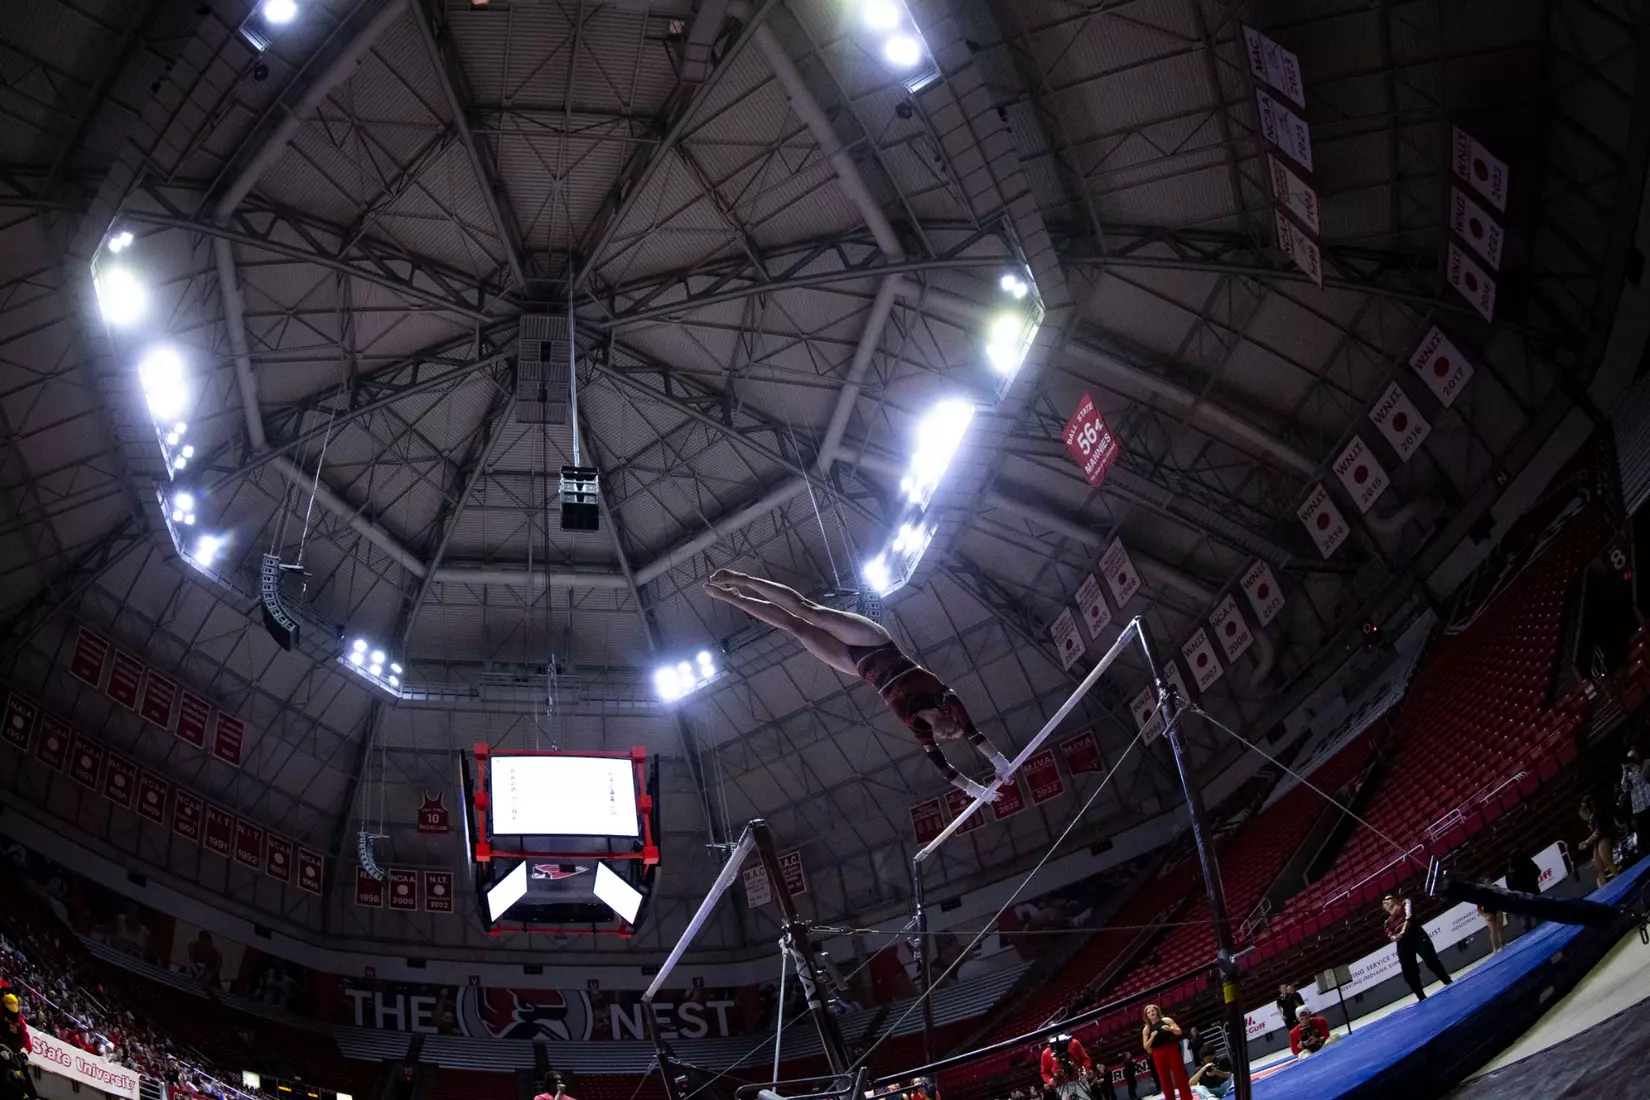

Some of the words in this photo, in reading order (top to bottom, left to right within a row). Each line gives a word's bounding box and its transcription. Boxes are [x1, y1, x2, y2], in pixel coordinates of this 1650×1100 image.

[1262, 97, 1276, 141] NCAA
[1443, 367, 1465, 397] 2017
[1067, 424, 1078, 445] BALL
[1077, 402, 1094, 421] STATE
[1077, 422, 1097, 455] 56
[1402, 426, 1422, 452] 2016
[1085, 432, 1112, 475] MANNIES
[1362, 477, 1382, 503] 2015
[1325, 527, 1344, 550] 2014
[1611, 549, 1626, 570] 8
[1212, 602, 1235, 628] NCAA
[1228, 633, 1248, 655] 2009
[1200, 665, 1217, 686] 2007
[11, 701, 31, 719] NAIA
[44, 721, 67, 739] NCAA
[75, 741, 100, 758] NCAA
[108, 759, 134, 777] NCAA
[141, 777, 166, 794] NCAA
[1036, 783, 1059, 798] 2022
[999, 800, 1020, 814] 2022
[427, 813, 440, 824] 10
[209, 836, 228, 850] 1991
[268, 840, 291, 854] NCAA
[238, 848, 257, 864] 1992
[300, 852, 322, 867] NCAA
[390, 874, 417, 884] NCAA
[359, 893, 380, 903] 1998
[392, 896, 414, 905] 2000
[1366, 955, 1390, 973] SERVICE
[1363, 967, 1388, 987] INDIANA
[345, 988, 439, 1034] THE
[609, 1000, 735, 1040] NEST
[32, 1036, 72, 1067] State
[76, 1056, 136, 1093] University
